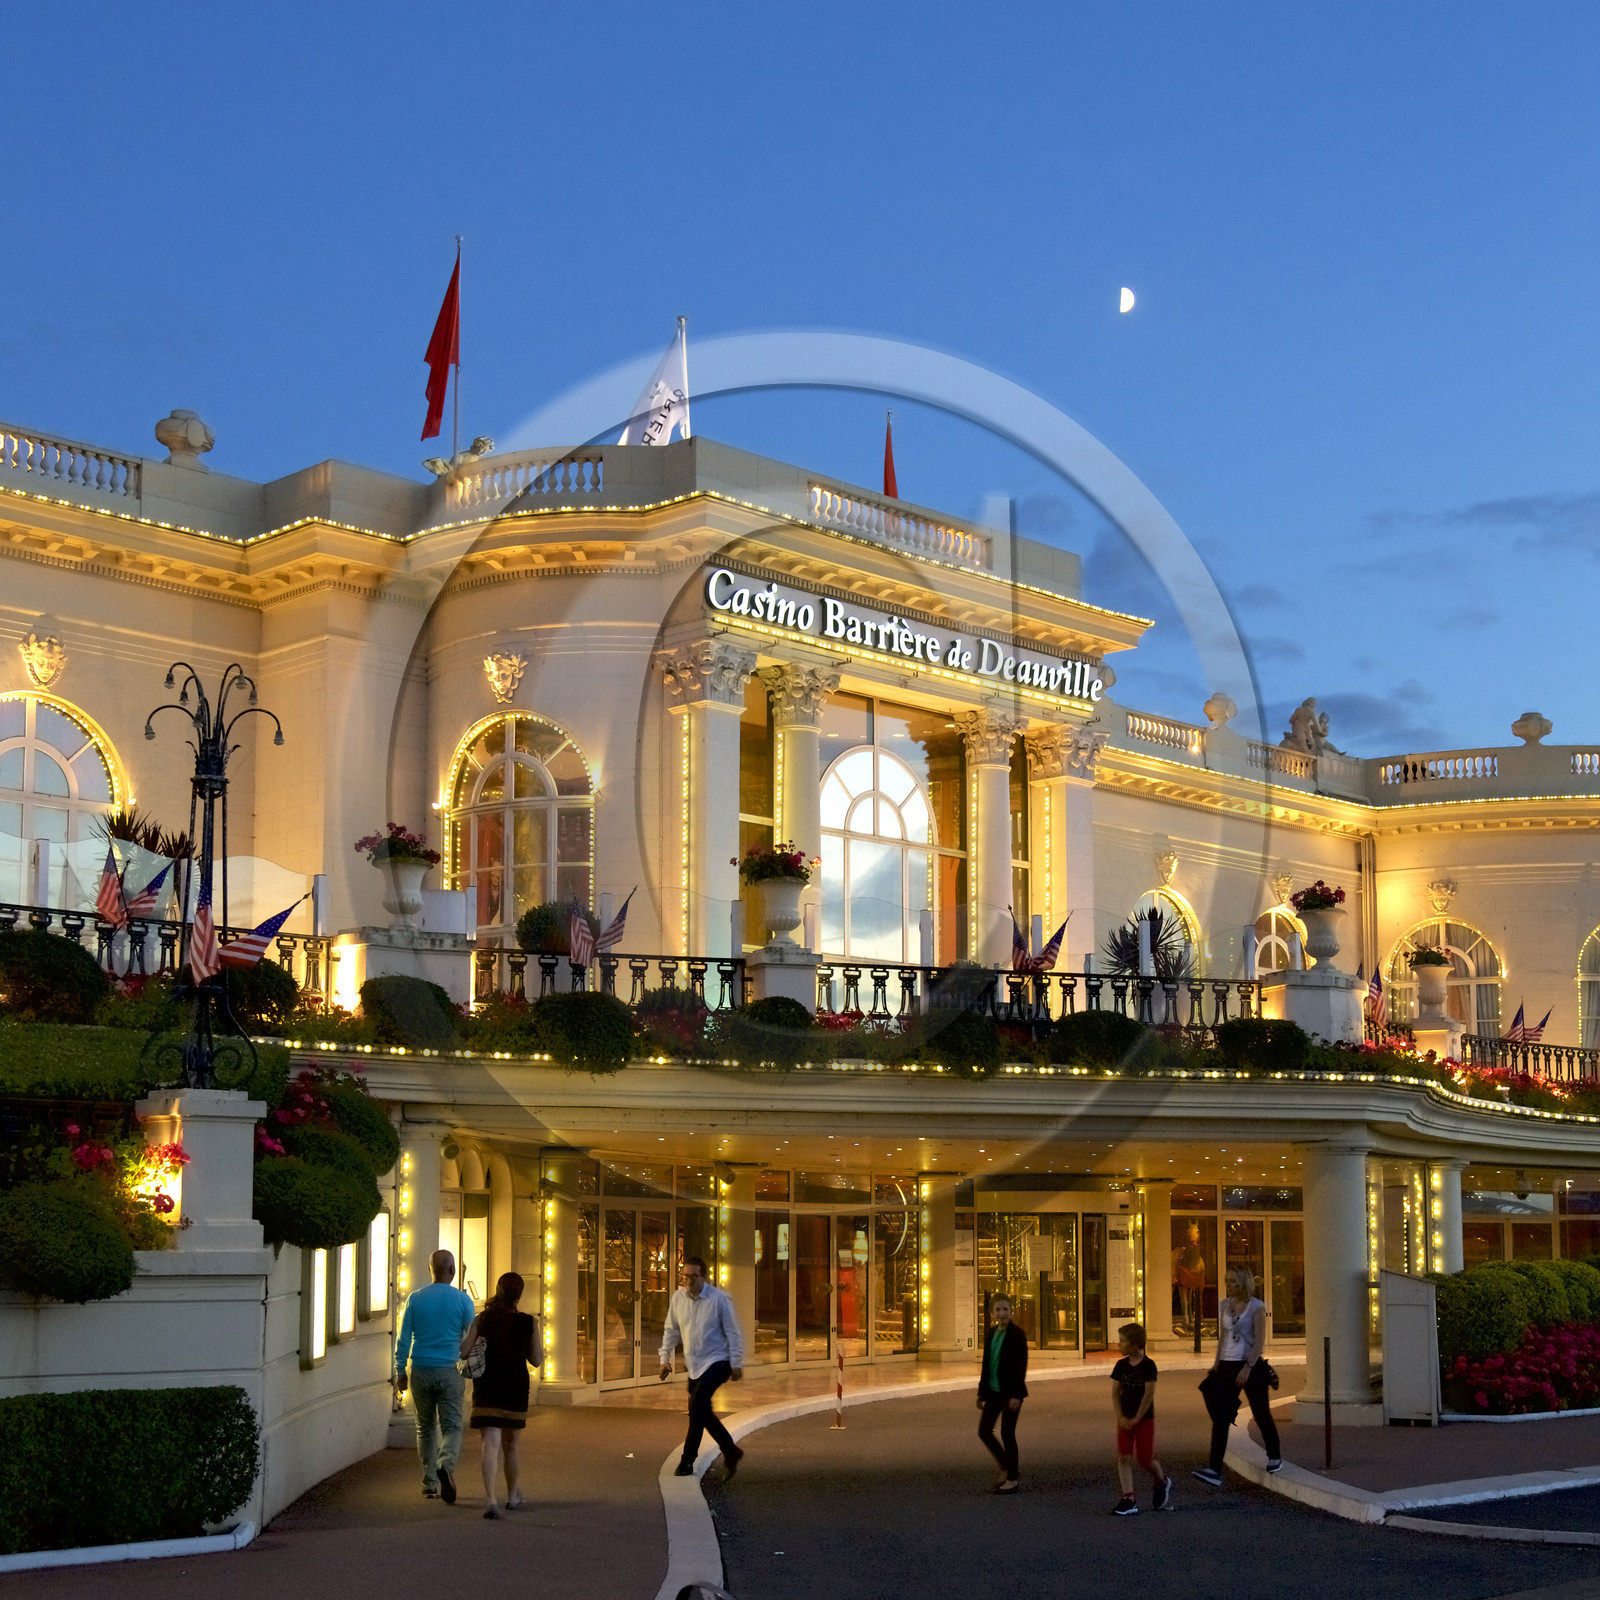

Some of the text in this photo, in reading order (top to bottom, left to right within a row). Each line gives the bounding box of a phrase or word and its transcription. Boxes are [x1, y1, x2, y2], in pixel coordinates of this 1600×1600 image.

[707, 568, 1104, 702] Casino Barrière de Deauville
